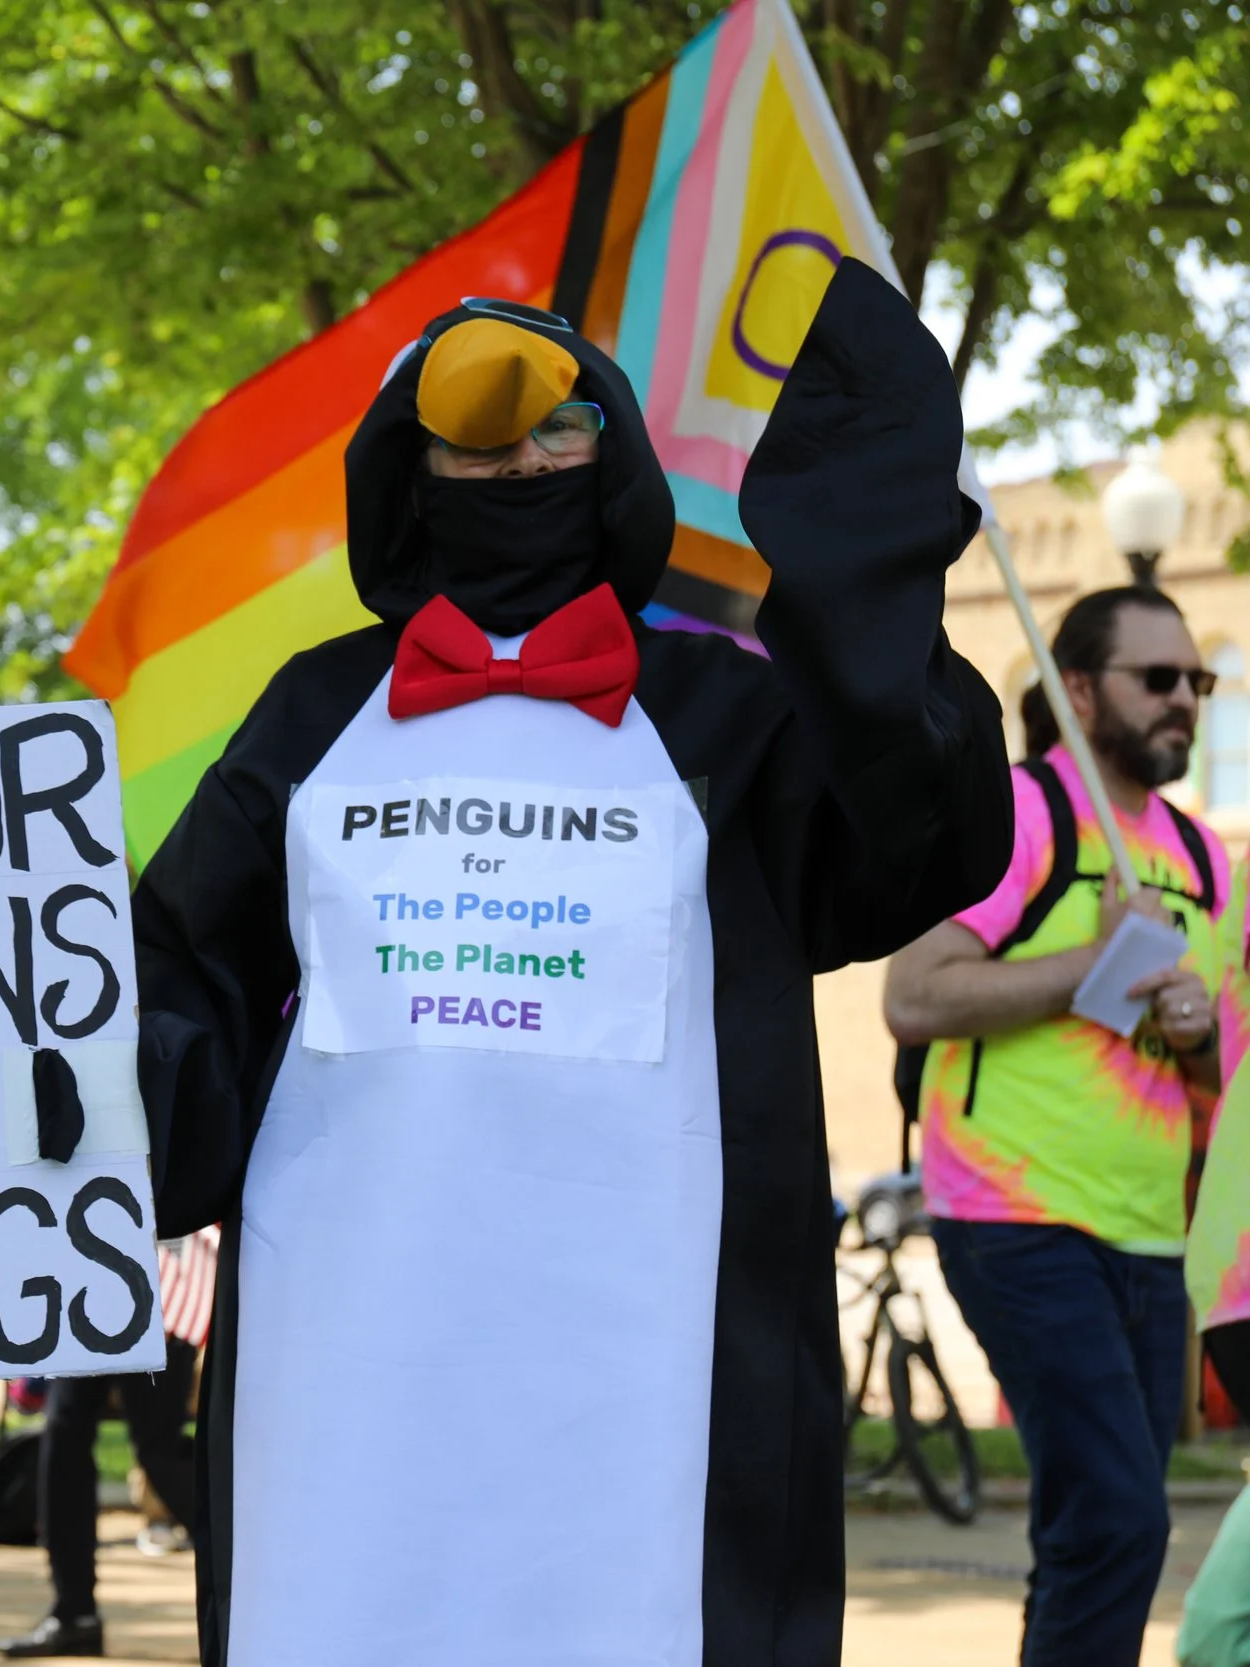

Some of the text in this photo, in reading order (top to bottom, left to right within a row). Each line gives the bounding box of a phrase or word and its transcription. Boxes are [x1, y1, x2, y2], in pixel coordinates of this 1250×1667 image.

[341, 797, 639, 843] PENGUINS
[461, 852, 506, 874] for
[373, 892, 591, 929] The People
[375, 944, 586, 979] The Planet
[411, 995, 543, 1031] PEACE
